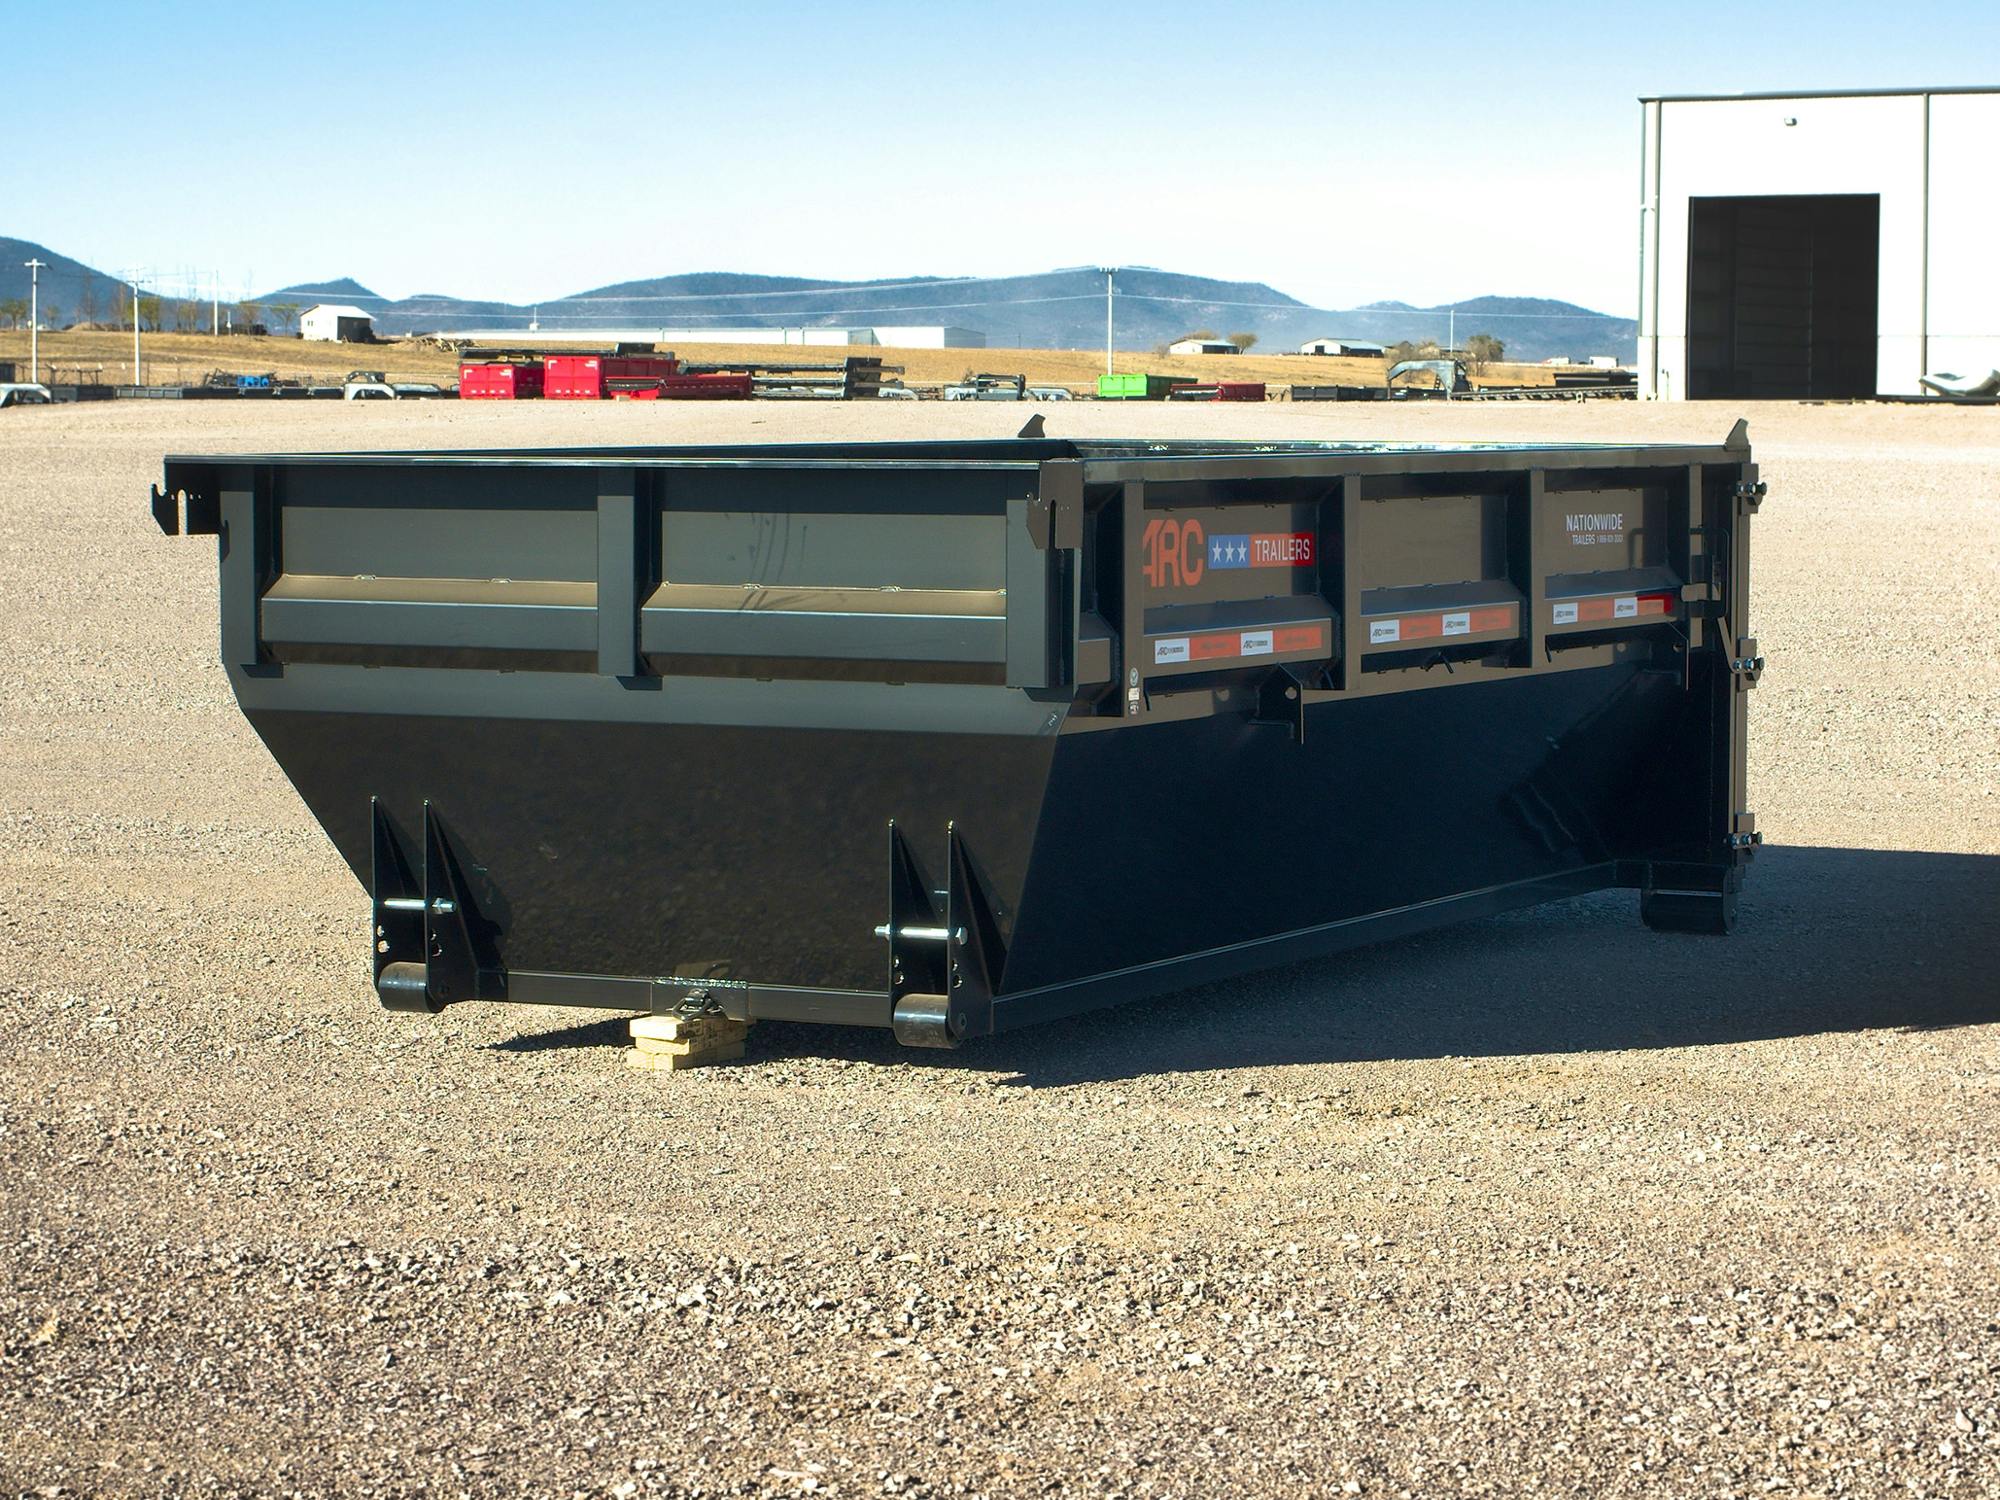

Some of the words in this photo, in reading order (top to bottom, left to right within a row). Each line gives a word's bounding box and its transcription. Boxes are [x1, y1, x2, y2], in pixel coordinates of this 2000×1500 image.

[1566, 513, 1623, 531] NATIONWIDE
[1572, 534, 1595, 545] TRAILERS
[1143, 519, 1203, 587] ARC
[1255, 539, 1310, 561] TRAILERS
